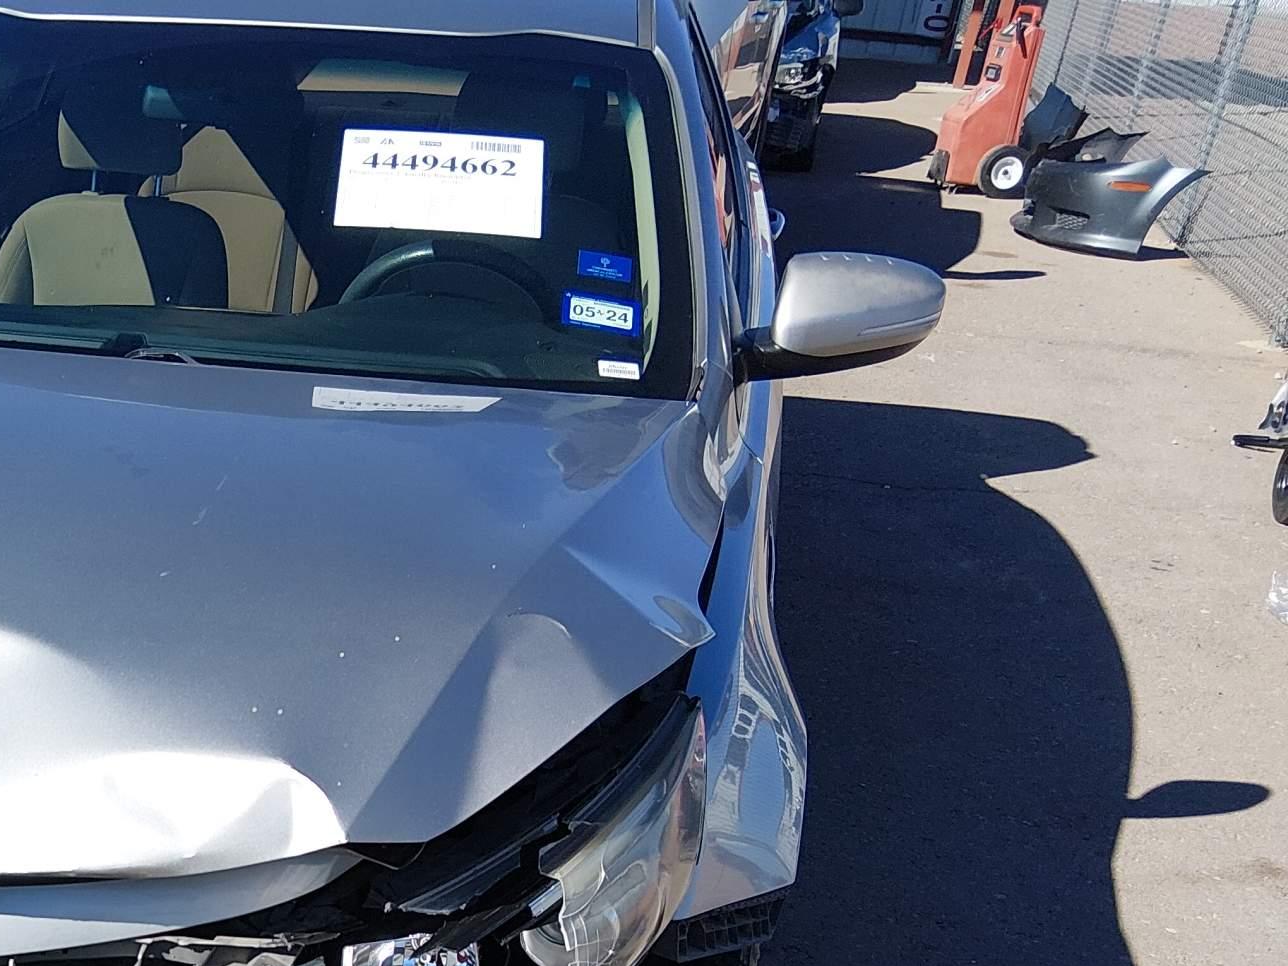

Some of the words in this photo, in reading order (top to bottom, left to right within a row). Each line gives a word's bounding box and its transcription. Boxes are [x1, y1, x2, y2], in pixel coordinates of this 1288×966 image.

[362, 152, 518, 177] 44494662
[572, 304, 596, 318] 05
[605, 309, 629, 324] 24
